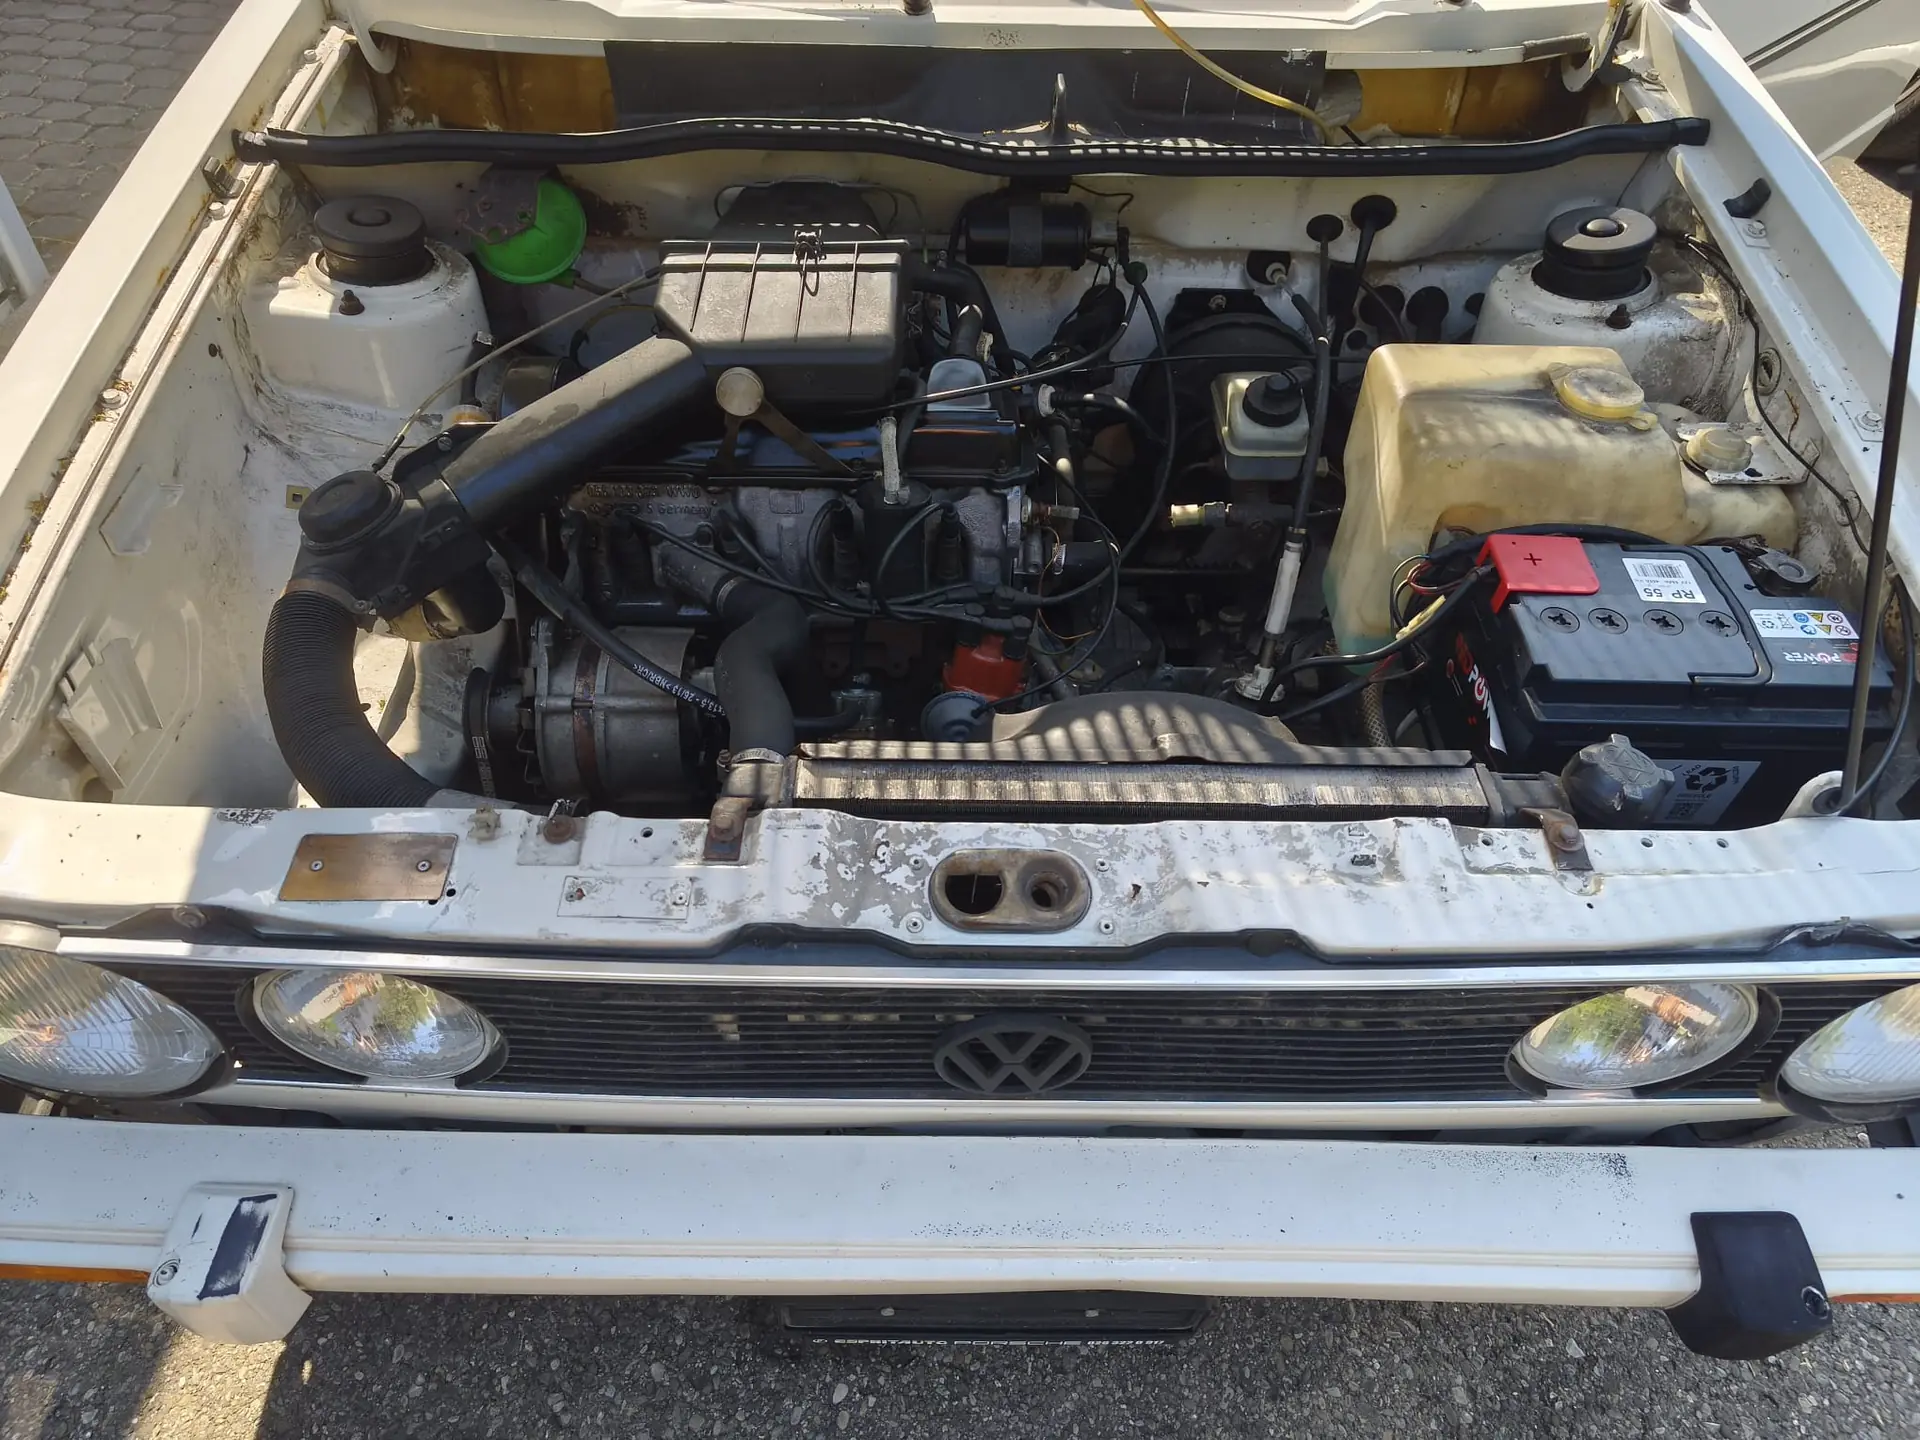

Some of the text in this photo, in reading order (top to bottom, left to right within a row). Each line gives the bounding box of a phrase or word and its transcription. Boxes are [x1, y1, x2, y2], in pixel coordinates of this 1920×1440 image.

[1643, 587, 1696, 600] RP 55
[1783, 651, 1843, 664] POWER
